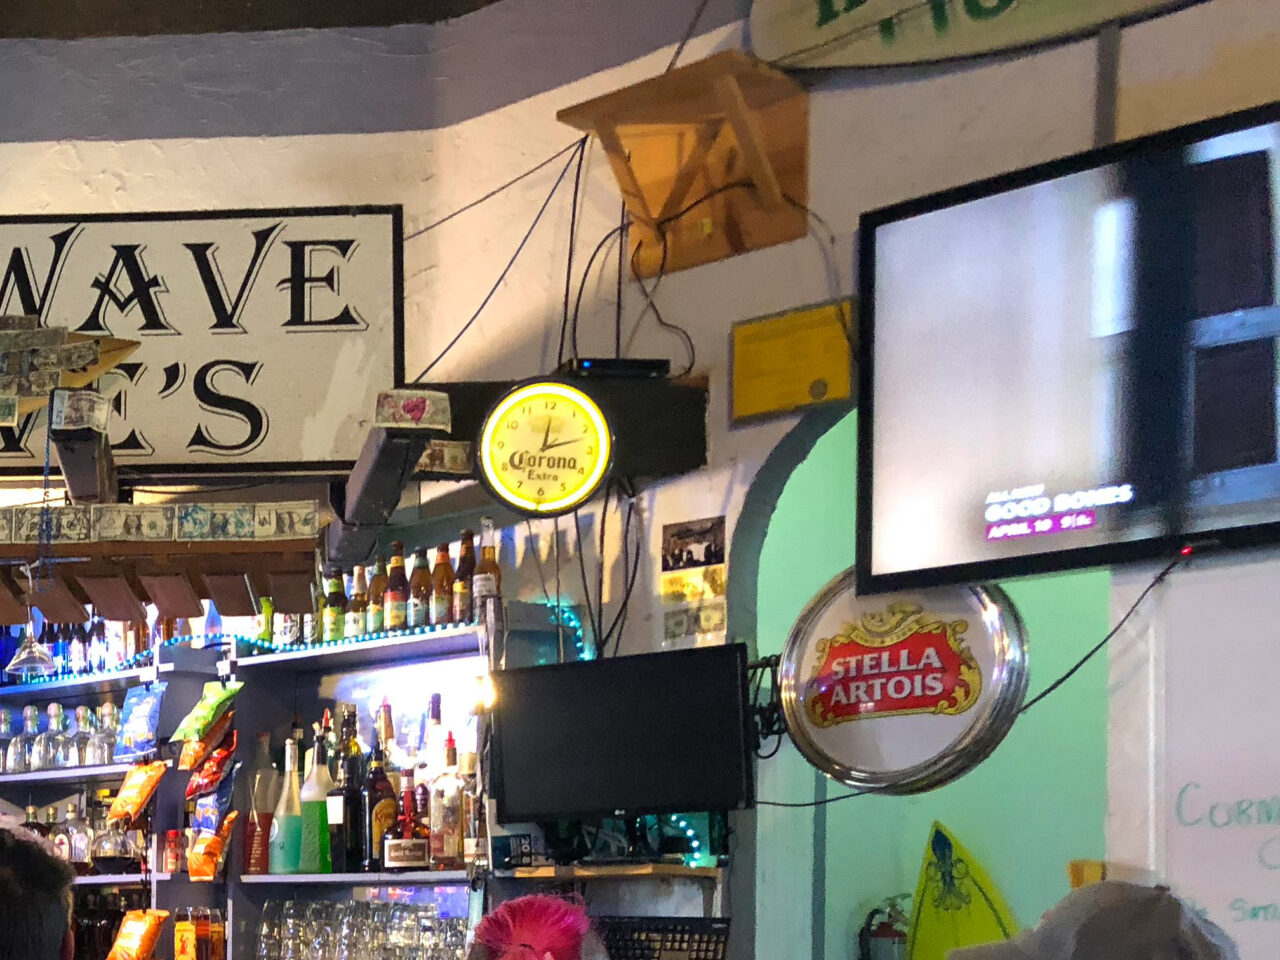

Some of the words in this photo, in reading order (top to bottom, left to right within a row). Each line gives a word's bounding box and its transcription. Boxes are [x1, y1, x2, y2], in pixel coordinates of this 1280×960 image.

[509, 449, 578, 473] Corona
[527, 469, 559, 482] Extra
[831, 646, 943, 681] STELLA
[831, 672, 944, 706] ARTOIS
